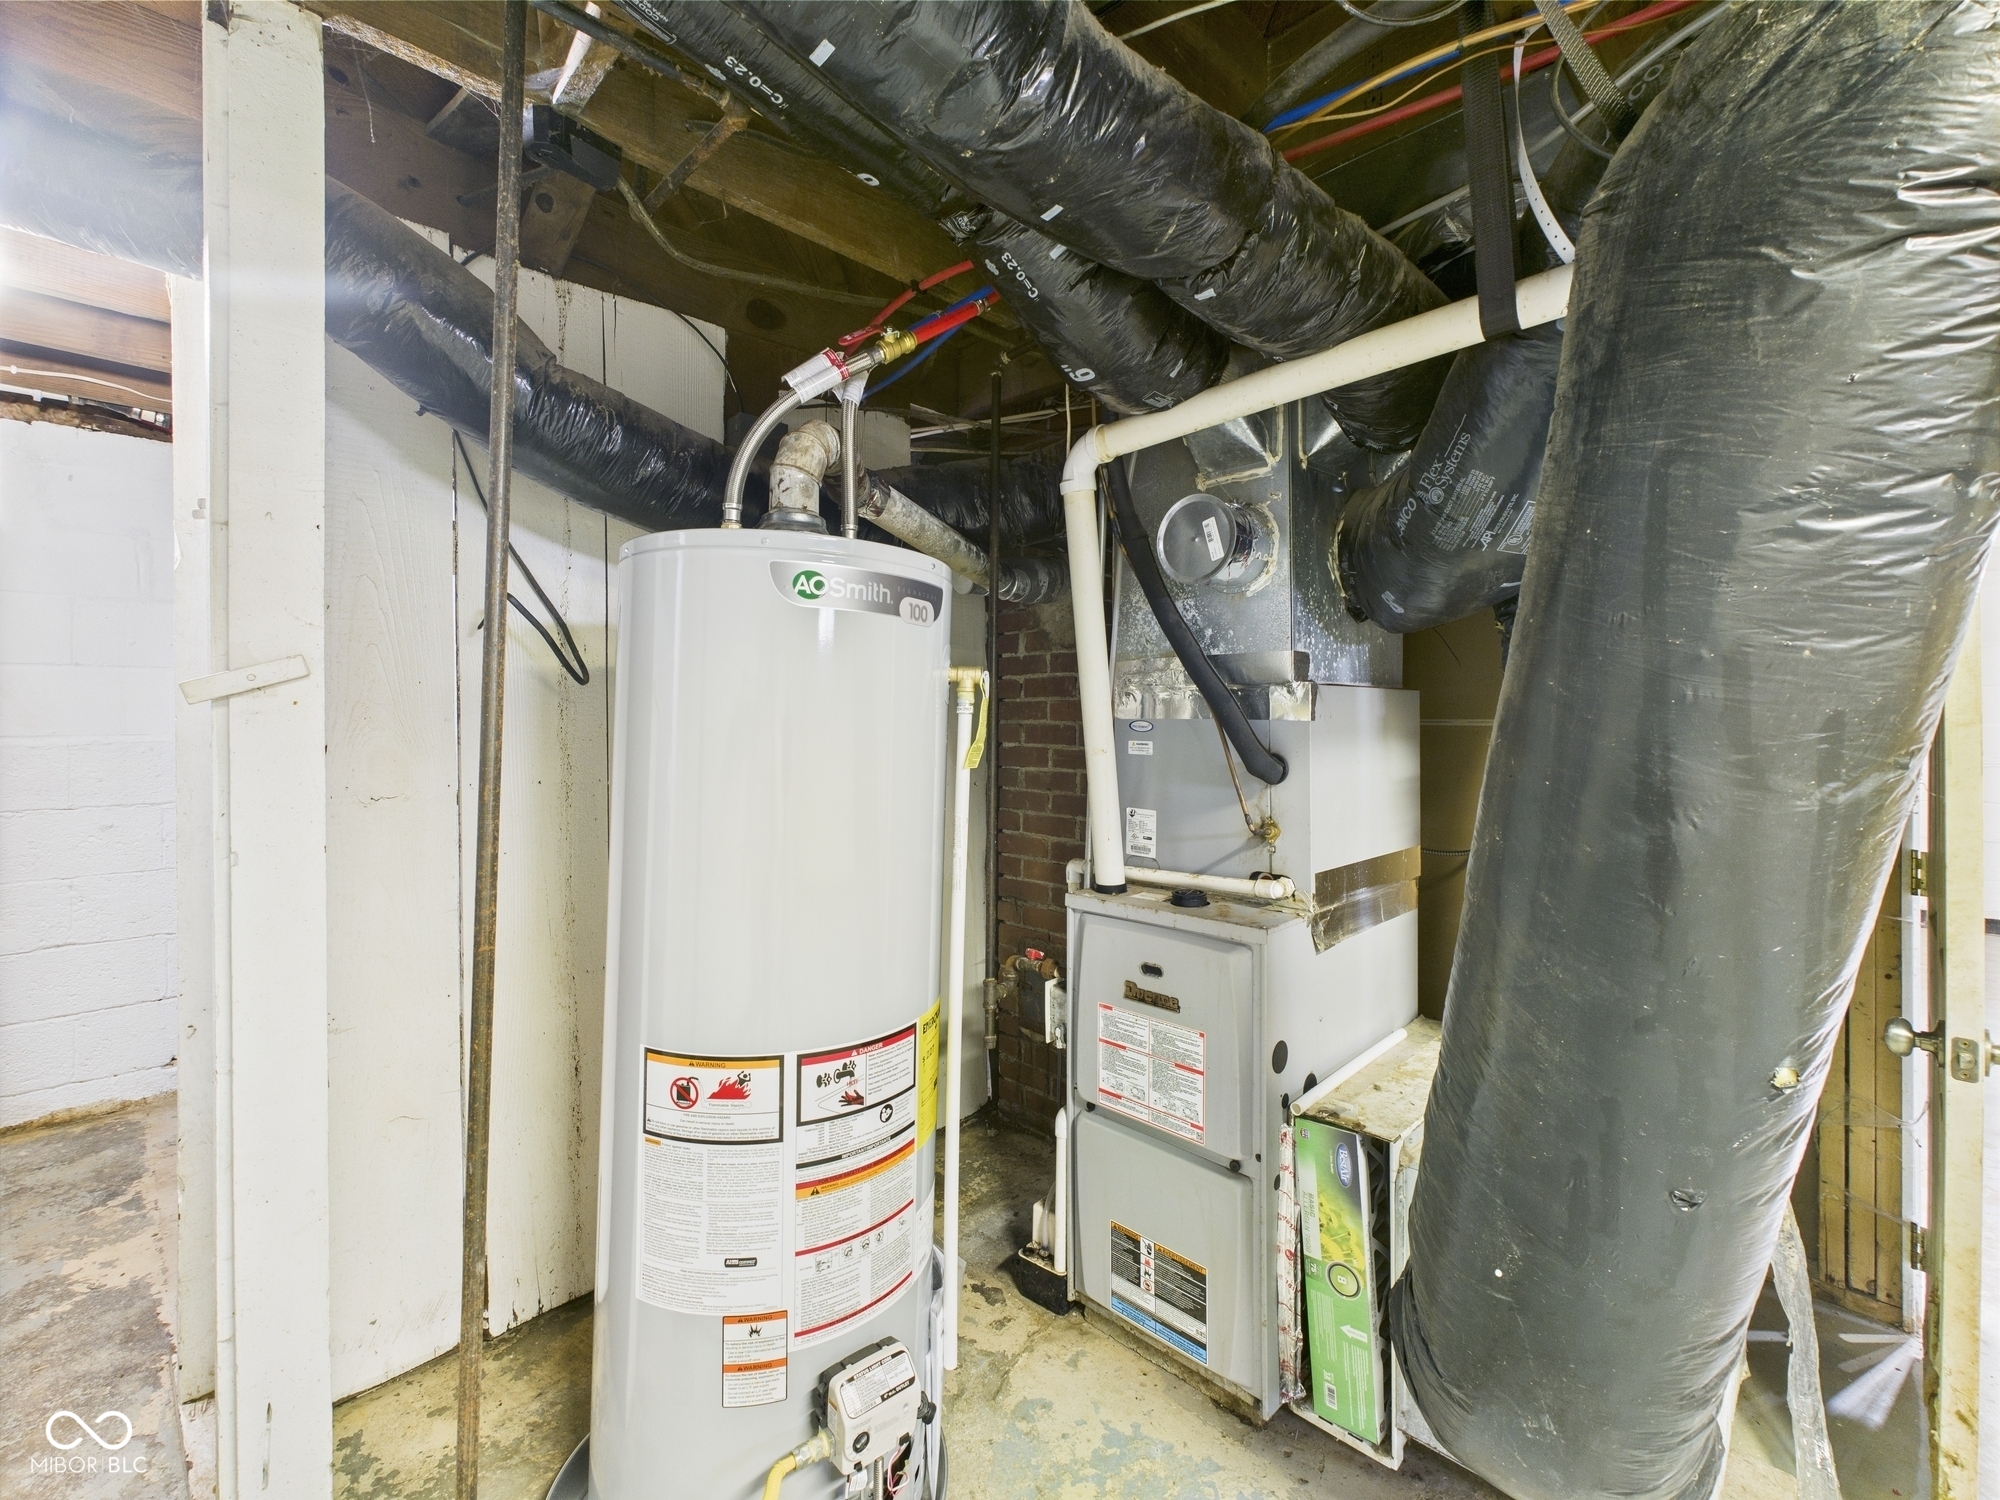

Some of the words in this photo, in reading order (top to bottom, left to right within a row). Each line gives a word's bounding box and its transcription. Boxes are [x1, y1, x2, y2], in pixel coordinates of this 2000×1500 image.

[724, 55, 784, 105] C=0.23
[1628, 61, 1664, 101] CO
[1001, 251, 1038, 300] C=0.23
[1419, 459, 1445, 490] Flex
[1436, 432, 1471, 489] Systems
[908, 602, 928, 623] 100
[859, 1042, 883, 1055] DANGER
[1338, 1148, 1350, 1182] BestAir
[1302, 1190, 1310, 1230] ALLERGEN
[1307, 1192, 1315, 1218] BASIC
[1337, 1274, 1347, 1285] 8
[744, 1363, 772, 1371] WARNING
